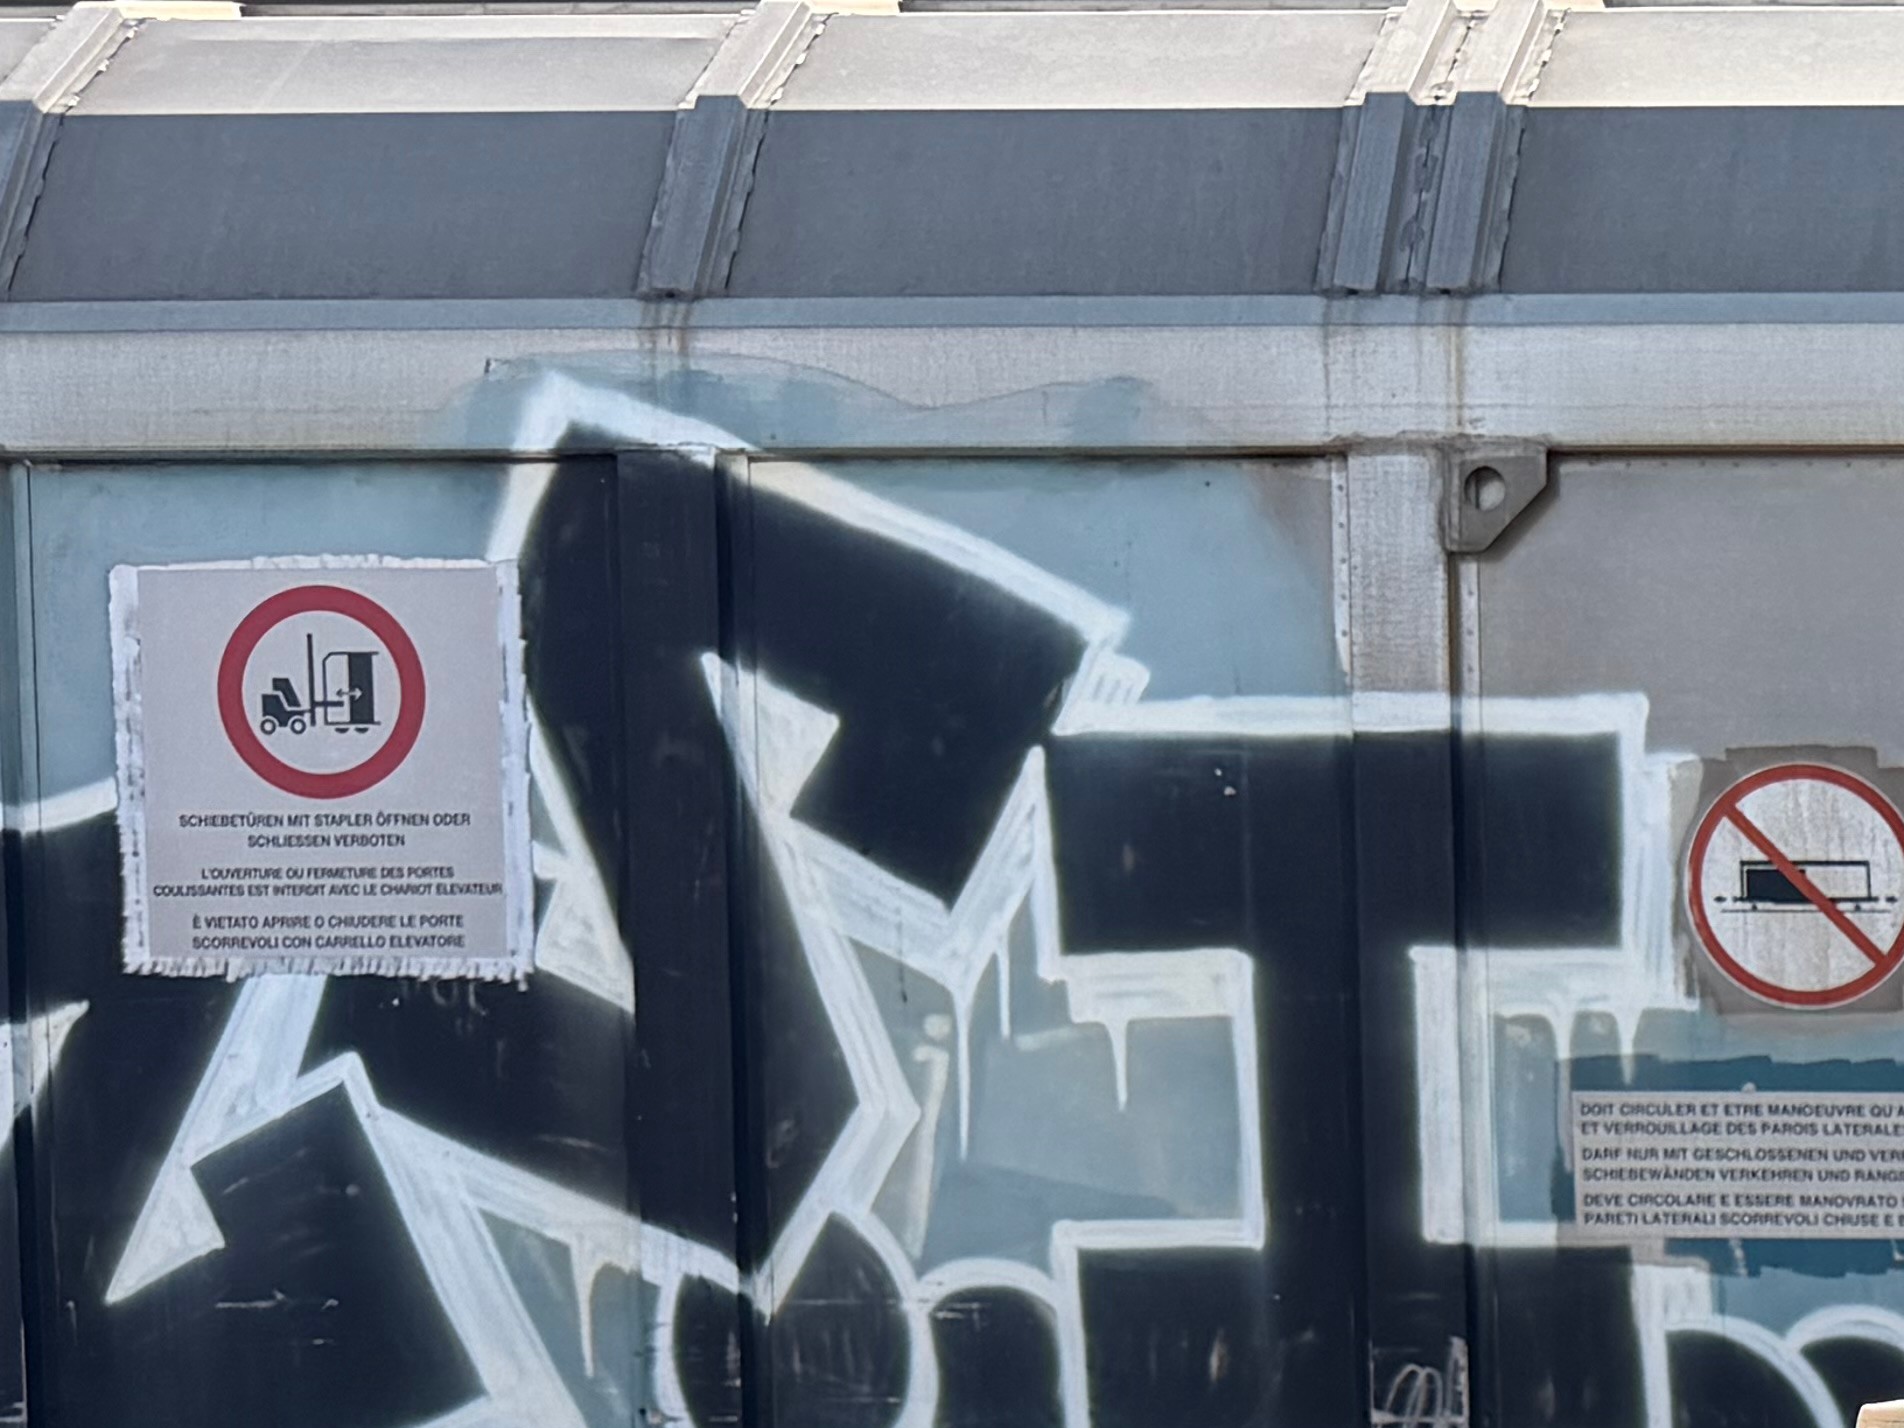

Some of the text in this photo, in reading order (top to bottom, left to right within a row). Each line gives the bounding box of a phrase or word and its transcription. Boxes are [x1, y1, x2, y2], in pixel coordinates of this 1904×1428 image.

[179, 810, 472, 828] SCHIEBETÜREN MIT STAPLER ÖFFNEN ODER
[248, 834, 406, 848] SCHLIESSEN VERBOTEN
[286, 867, 304, 880] OU
[307, 867, 377, 880] FERMETURE
[380, 867, 404, 879] DES
[407, 866, 455, 879] PORTES
[153, 884, 245, 897] COULISSANTES
[248, 884, 269, 897] EST
[273, 884, 326, 897] INTERDIT
[329, 884, 360, 896] AVEC
[363, 884, 377, 896] LE
[380, 884, 433, 896] CHARIOT
[204, 915, 259, 929] VIETATO
[262, 915, 311, 929] APRIRE
[314, 915, 325, 929] O
[328, 915, 397, 929] CHIUDERE
[400, 915, 416, 929] LE
[420, 915, 464, 929] PORTE
[193, 935, 465, 950] SCORREVOLI CON CARRELLO ELEVATORE
[1580, 1104, 1613, 1116] DOIT
[1620, 1104, 1696, 1116] CIRCULER
[1701, 1104, 1719, 1116] ET
[1725, 1104, 1763, 1116] ETRE
[1768, 1104, 1866, 1117] MANOEUVRE
[1581, 1121, 1599, 1135] ET
[1604, 1121, 1722, 1135] VERROUILLAGE
[1727, 1121, 1757, 1135] DES
[1761, 1123, 1818, 1136] PAROIS
[1582, 1148, 1622, 1161] DARF
[1627, 1148, 1659, 1161] NUR
[1663, 1148, 1688, 1161] MIT
[1692, 1148, 1828, 1161] GESCHLOSSENEN
[1833, 1149, 1866, 1162] UND
[1583, 1165, 1716, 1182] SCHIEBEWÄNDEN
[1719, 1168, 1813, 1182] VERKEHREN
[1817, 1168, 1850, 1182] UND
[1583, 1194, 1624, 1207] DEVE
[1628, 1194, 1716, 1207] CIRCOLARE
[1720, 1194, 1730, 1207] E
[1734, 1194, 1794, 1207] ESSERE
[1799, 1194, 1898, 1208] MANOVRATO
[1584, 1212, 1638, 1225] PARETI
[1642, 1212, 1716, 1225] LATERALI
[1720, 1213, 1819, 1226] SCORREVOLI
[1823, 1213, 1879, 1227] CHIUSE
[1884, 1213, 1894, 1227] E
